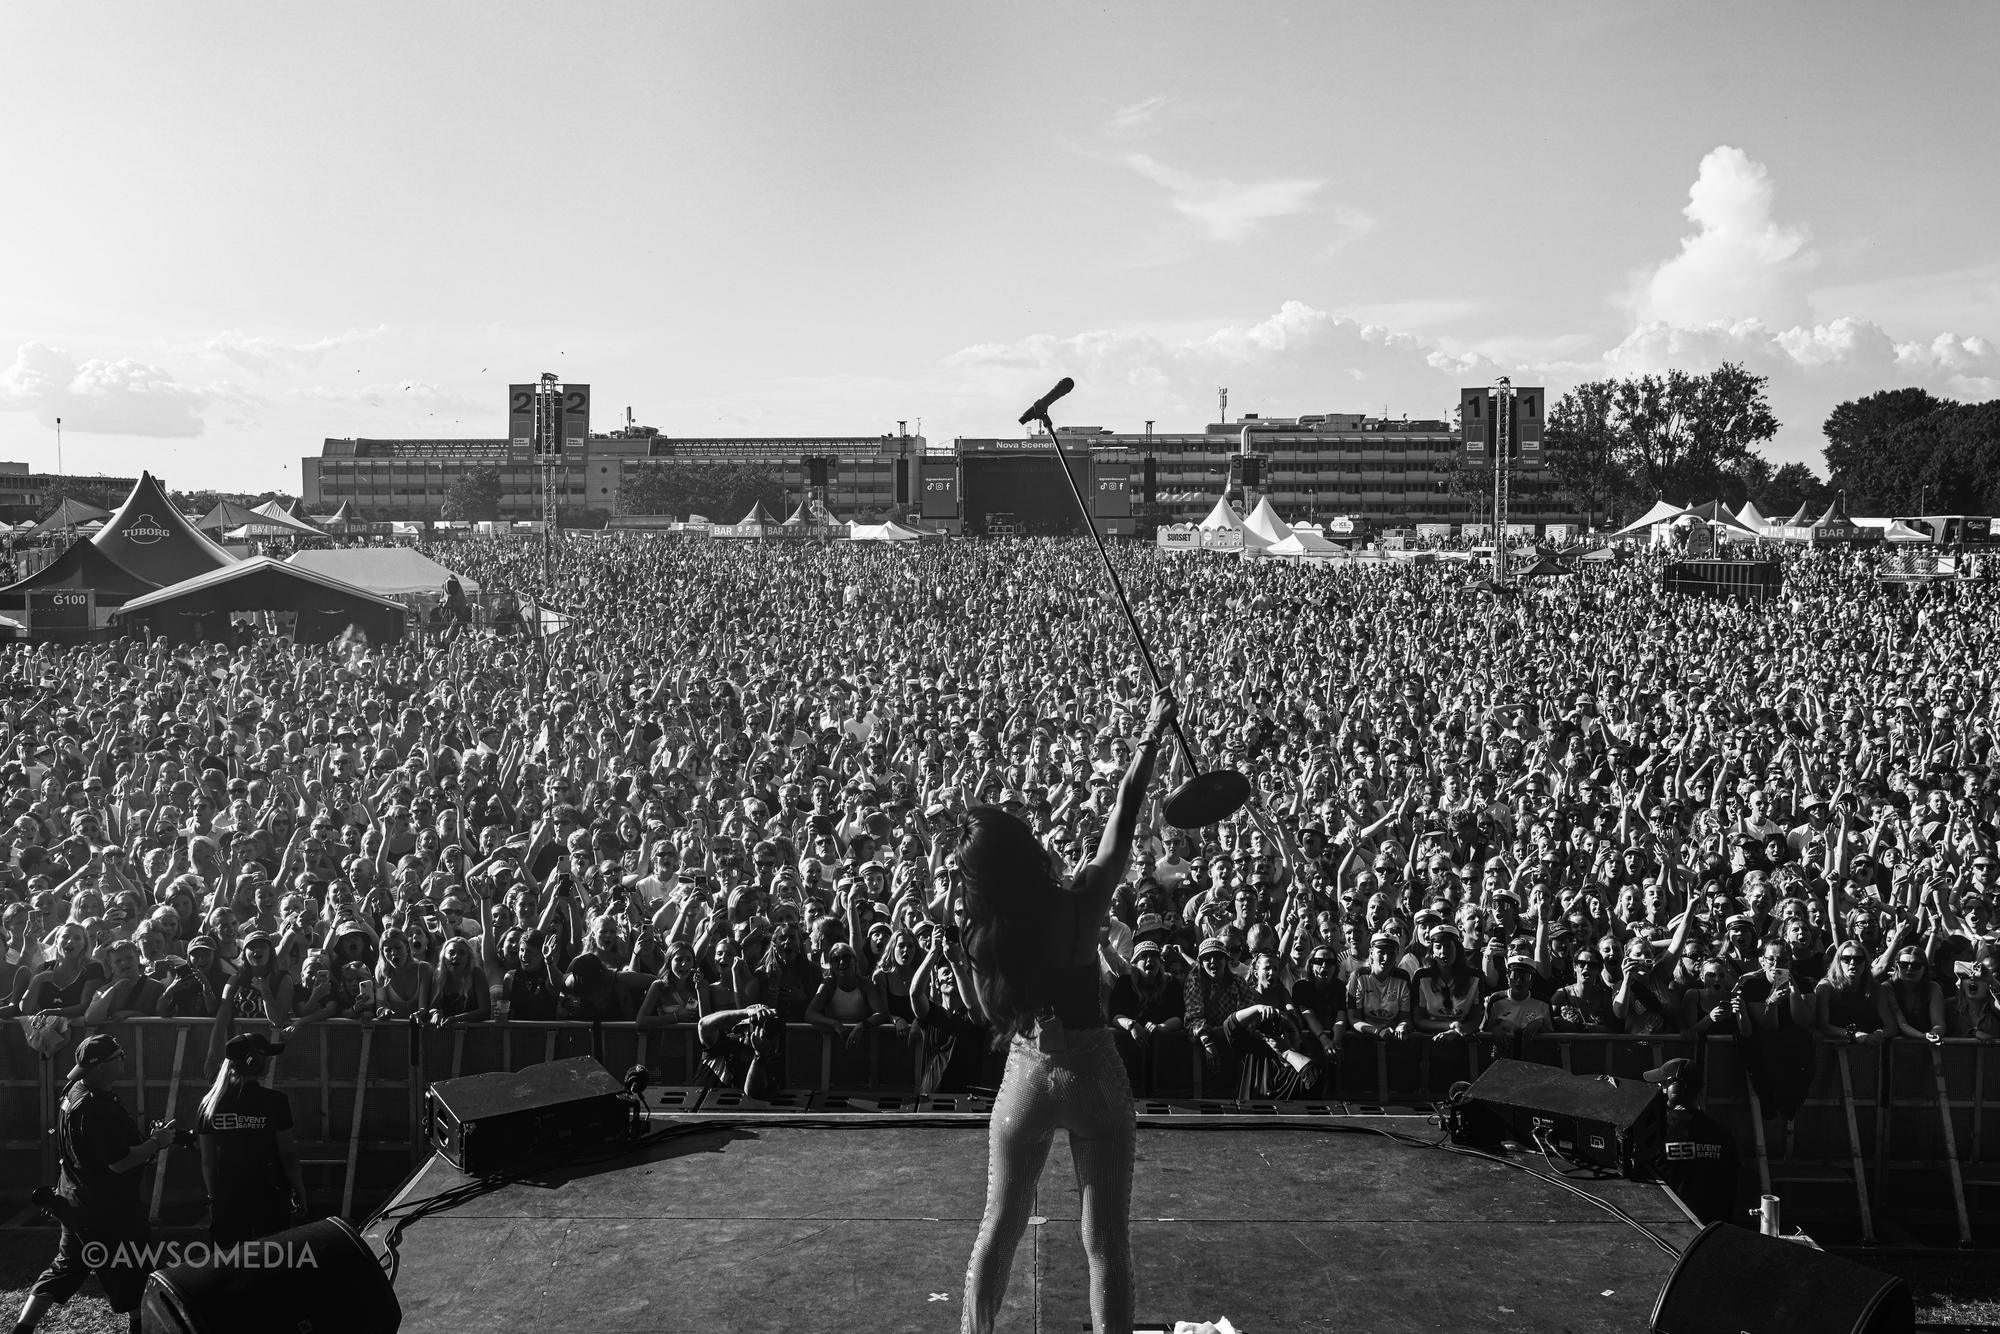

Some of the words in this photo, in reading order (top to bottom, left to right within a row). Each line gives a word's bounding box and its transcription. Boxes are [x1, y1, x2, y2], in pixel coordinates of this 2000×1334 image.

[512, 392, 532, 414] 2
[566, 392, 586, 415] 2
[1468, 395, 1481, 418] 1
[1523, 395, 1536, 417] 1
[996, 441, 1019, 449] Nova
[1021, 441, 1055, 449] Scenen
[828, 458, 838, 469] 4
[1232, 459, 1242, 470] 3
[1258, 459, 1267, 470] 3
[122, 528, 170, 537] TUBORG
[350, 524, 368, 533] BAR
[714, 525, 733, 536] BAR
[767, 526, 784, 536] BAR
[812, 526, 828, 535] BR
[1819, 528, 1845, 538] BAR
[53, 594, 86, 605] G100
[239, 1115, 267, 1123] EVENT
[1696, 1143, 1721, 1152] EVENT
